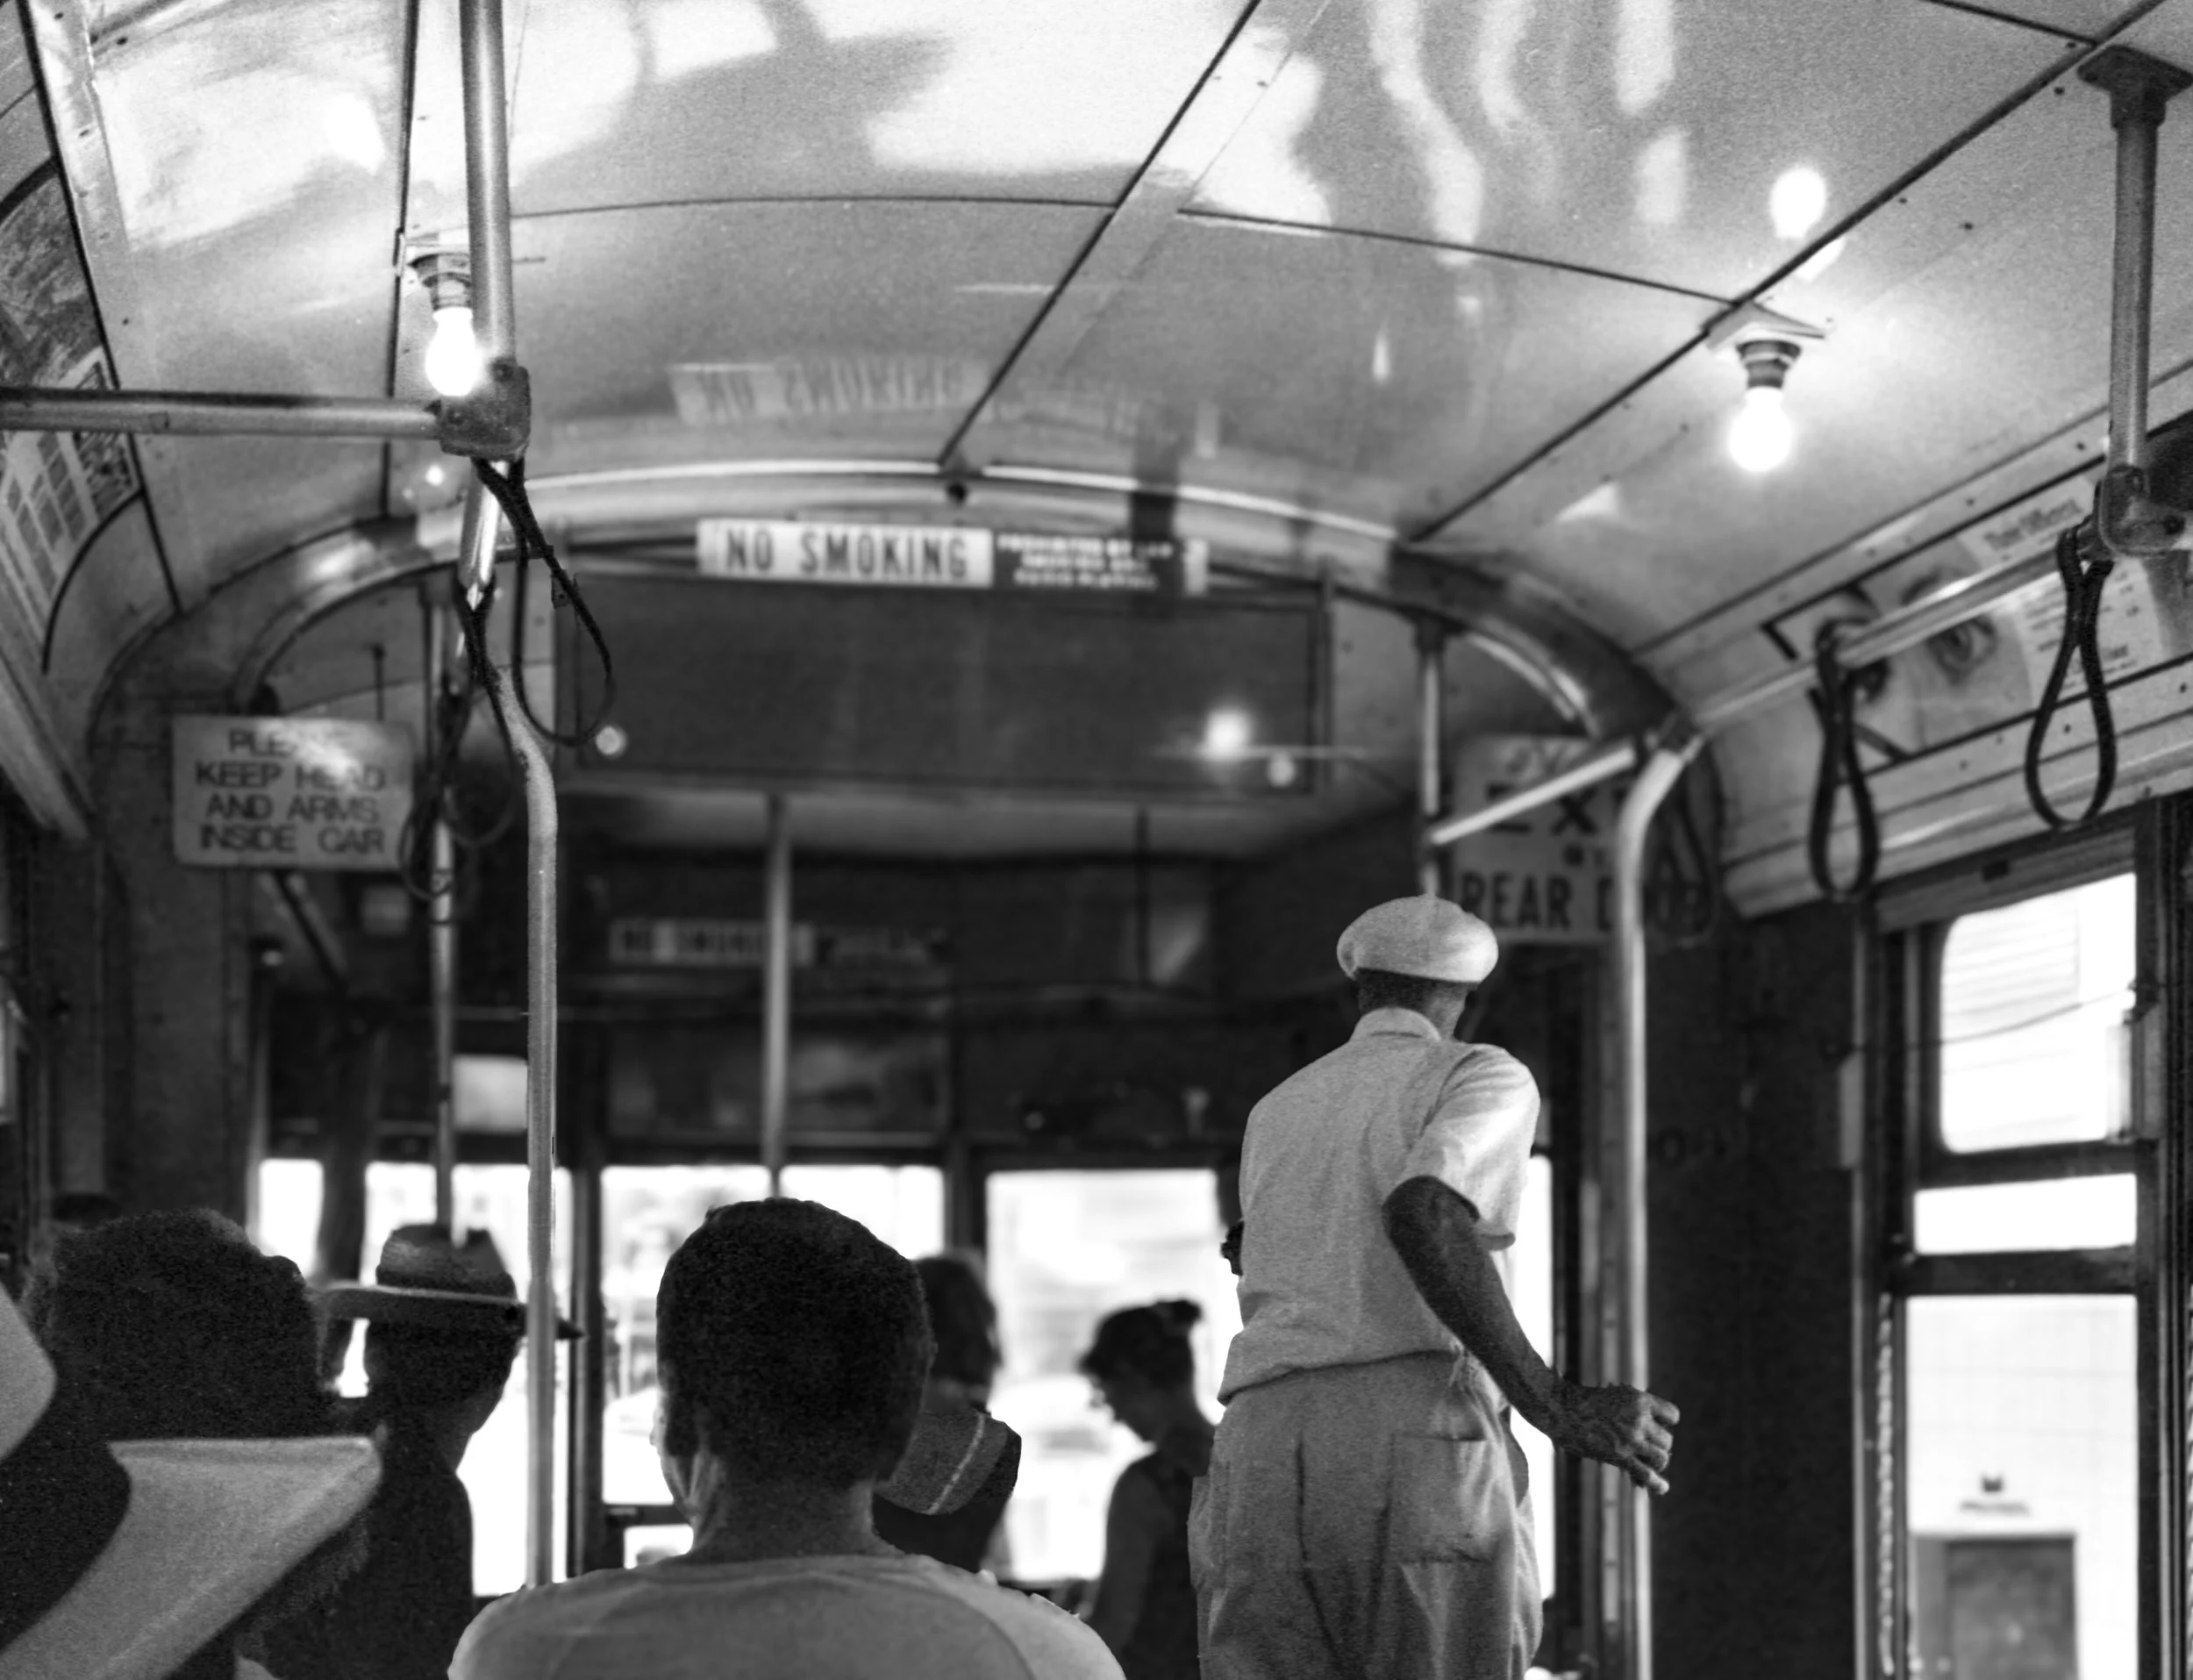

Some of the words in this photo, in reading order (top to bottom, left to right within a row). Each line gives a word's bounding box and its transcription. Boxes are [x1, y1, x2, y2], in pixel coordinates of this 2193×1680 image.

[725, 528, 774, 570] NO
[798, 529, 968, 578] SMOKING
[194, 760, 282, 788] KEEP
[205, 793, 275, 821] AND
[286, 794, 381, 824] ARMS
[198, 823, 297, 854] INSIDE
[317, 826, 384, 855] CAR
